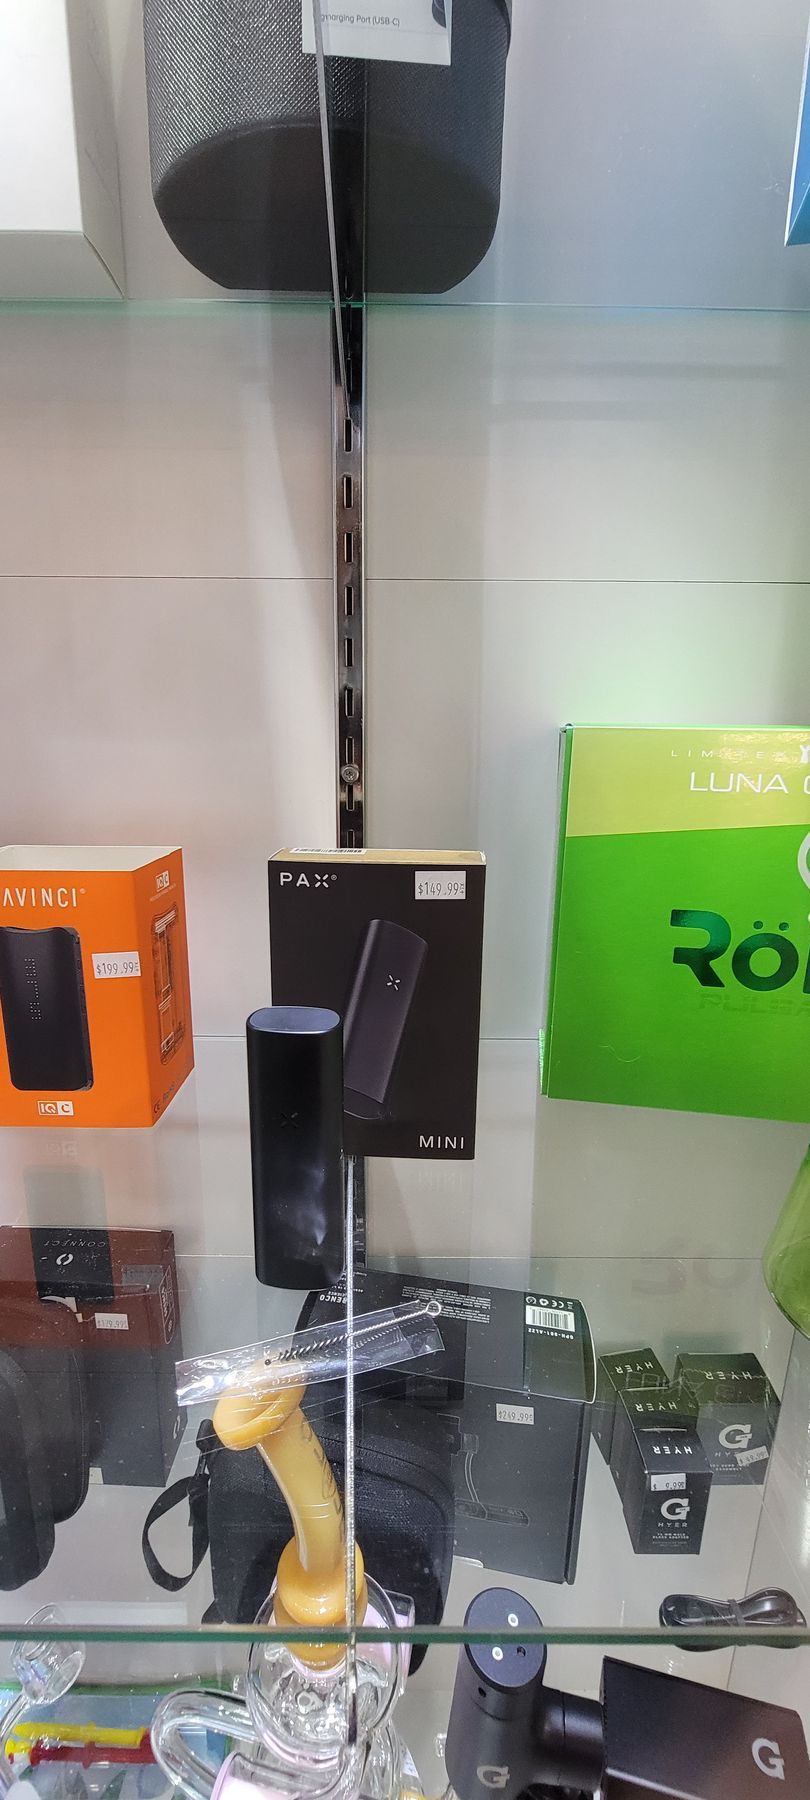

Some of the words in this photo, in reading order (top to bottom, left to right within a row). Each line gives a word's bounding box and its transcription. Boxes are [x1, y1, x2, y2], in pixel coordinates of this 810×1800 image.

[356, 15, 371, 24] Port
[690, 772, 789, 794] LUNA
[280, 872, 329, 888] PAX
[418, 882, 459, 896] $149.99
[97, 961, 134, 976] $199.99
[419, 1135, 465, 1150] MINI
[615, 1361, 654, 1374] HYER
[703, 1371, 753, 1380] HYER
[635, 1402, 678, 1412] HYER
[652, 1446, 693, 1455] HYER
